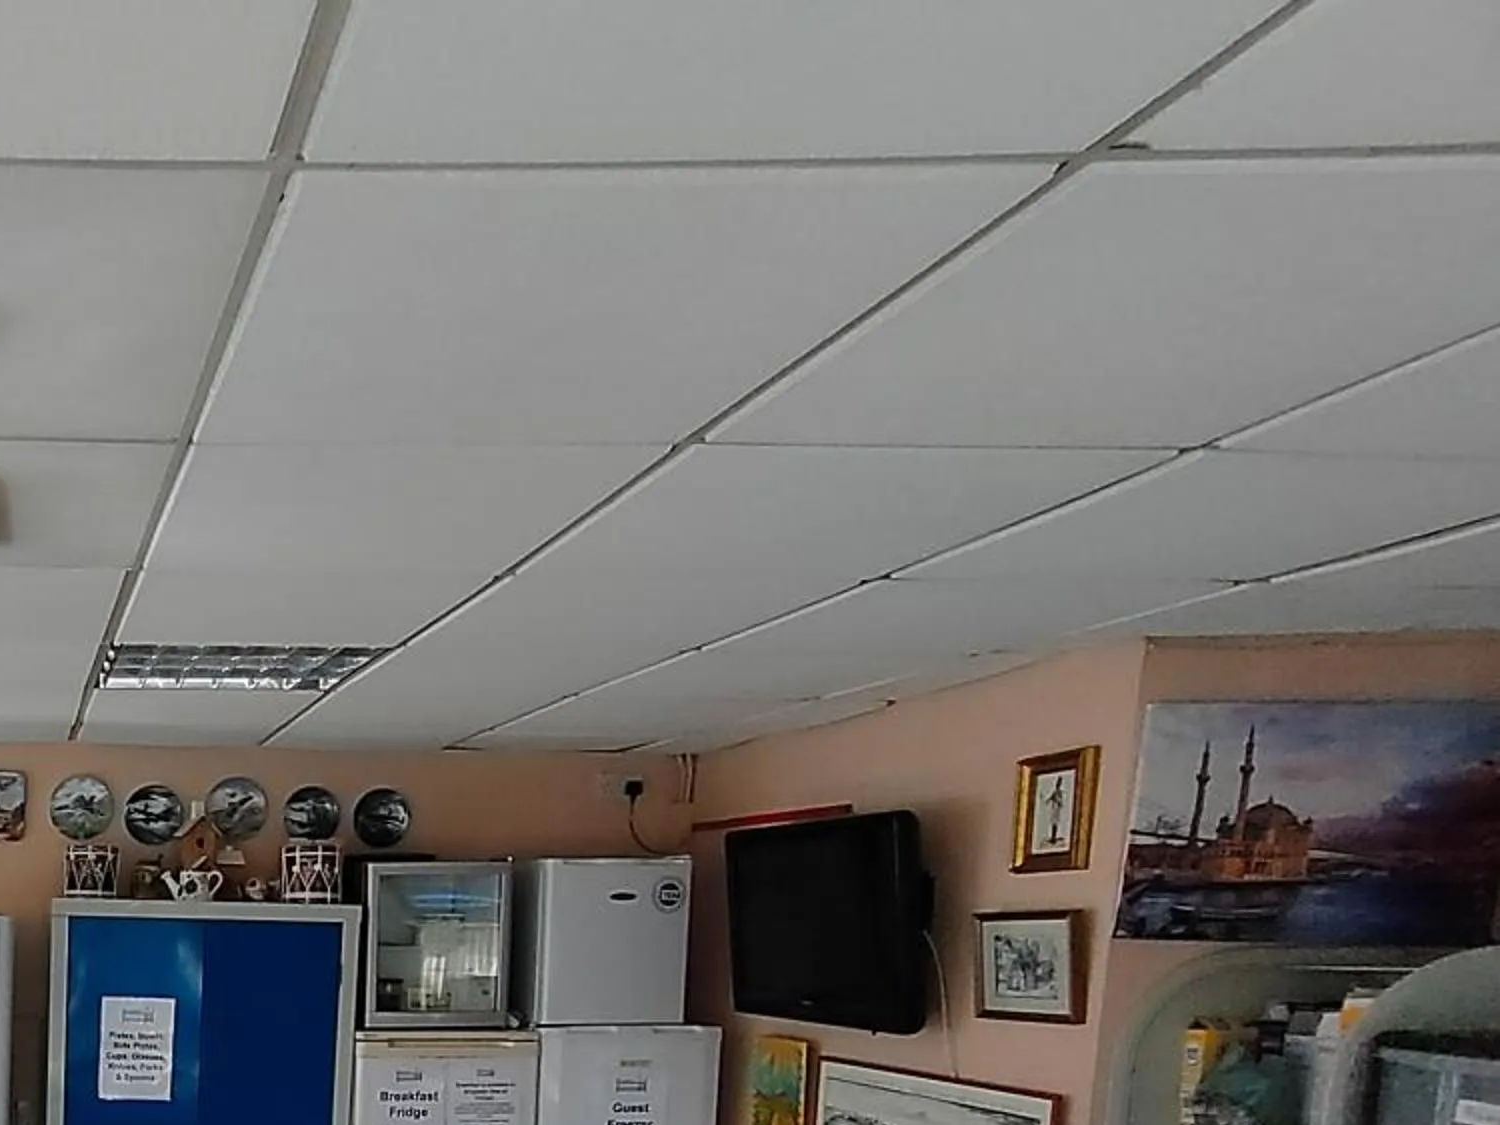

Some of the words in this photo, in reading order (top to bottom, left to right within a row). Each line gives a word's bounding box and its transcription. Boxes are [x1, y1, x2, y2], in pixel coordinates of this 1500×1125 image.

[379, 1091, 439, 1102] Breakfast
[612, 1102, 649, 1113] Guest
[389, 1107, 428, 1120] Fridge
